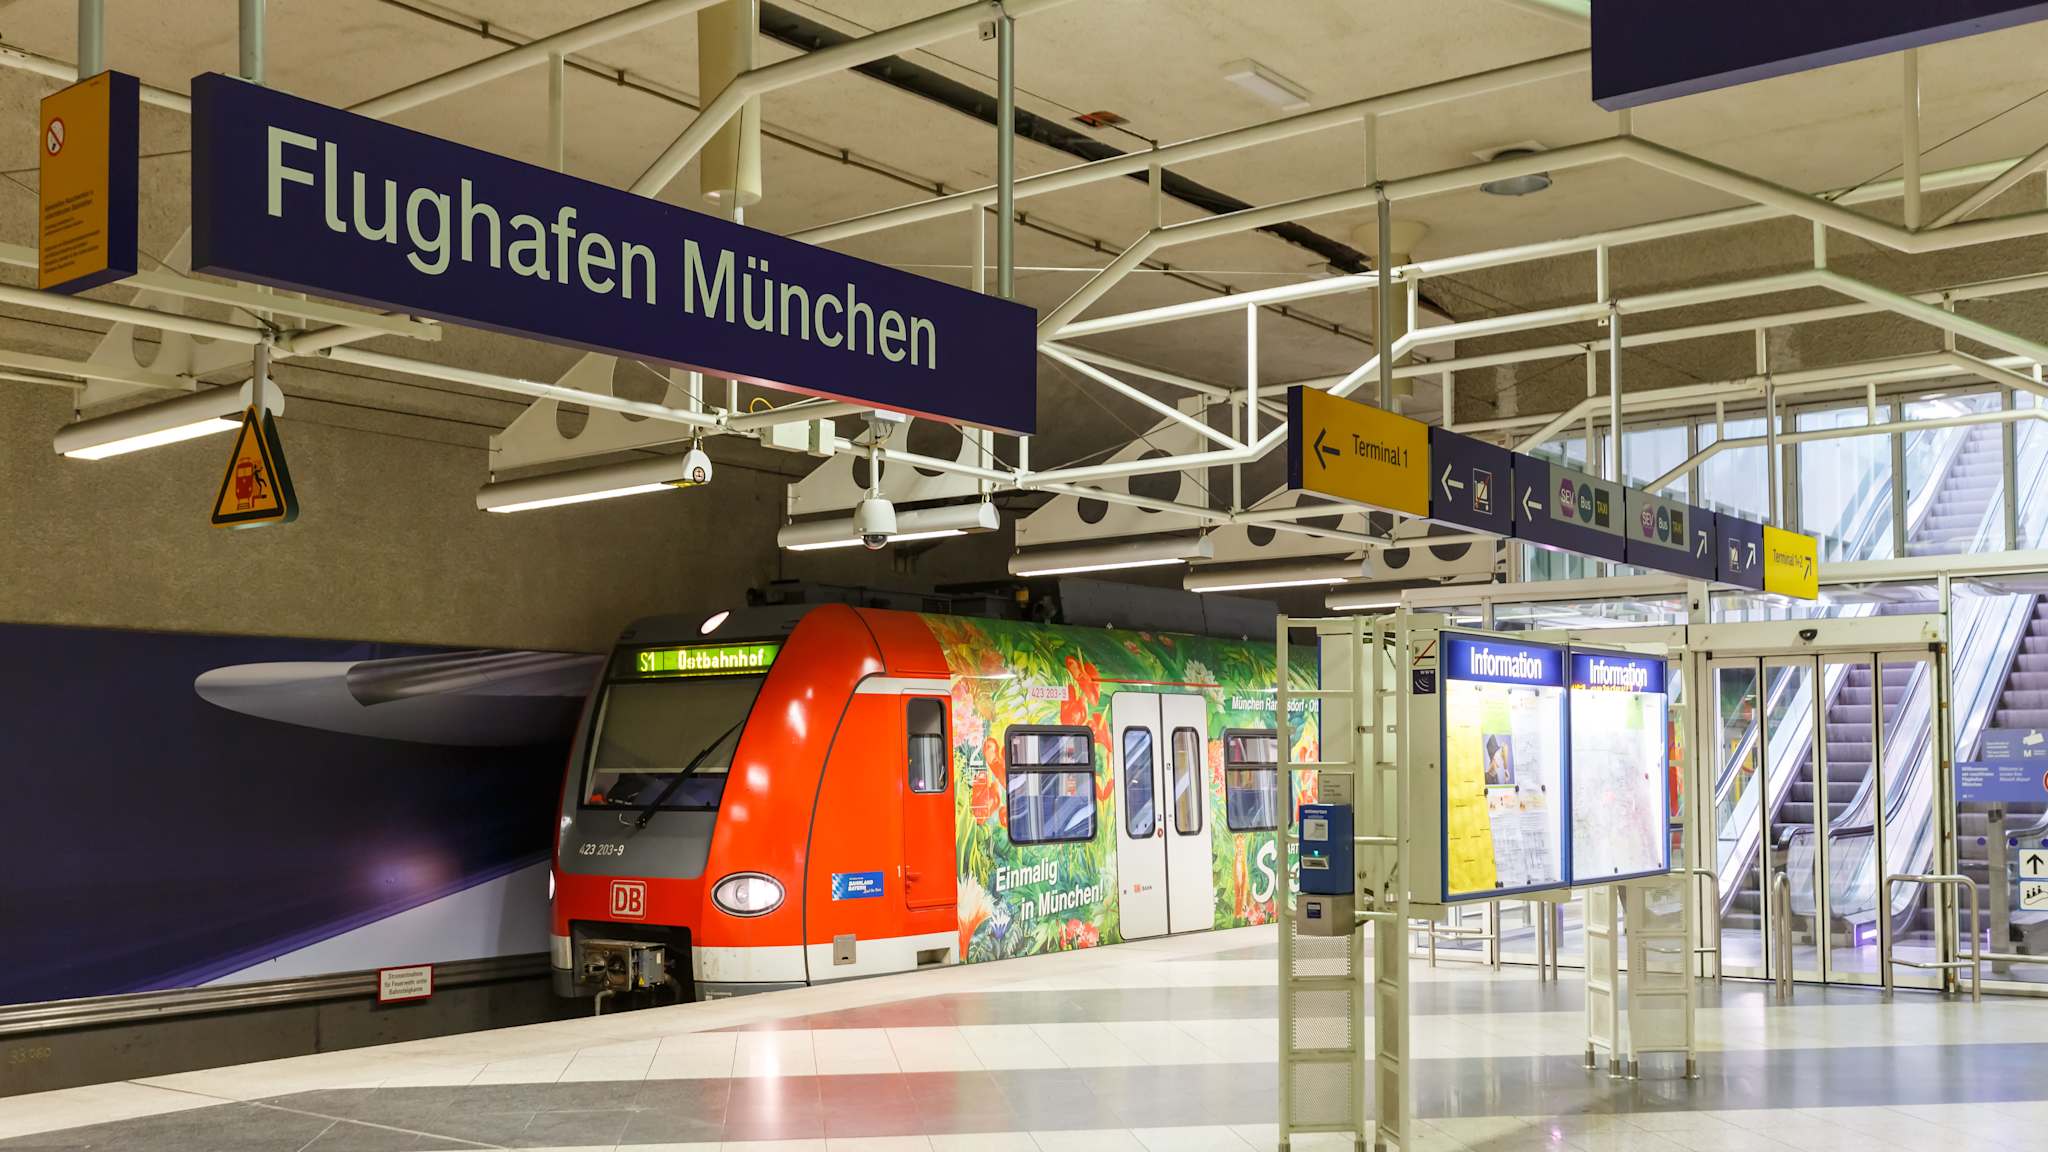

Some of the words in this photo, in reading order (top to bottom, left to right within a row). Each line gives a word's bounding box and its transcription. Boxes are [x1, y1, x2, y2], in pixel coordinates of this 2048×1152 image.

[268, 125, 657, 305] Flughafen
[684, 238, 936, 370] München
[1352, 433, 1400, 466] Terminal
[1403, 449, 1408, 469] 1
[1560, 488, 1575, 505] SEV
[1580, 496, 1591, 510] Bus
[1597, 500, 1608, 515] TAXI
[1642, 511, 1654, 526] SEV
[1658, 517, 1668, 530] Bus
[640, 651, 655, 672] S1
[678, 648, 765, 670] Ostbahnhof
[1470, 646, 1543, 679] Information
[1589, 658, 1648, 688] Information
[1231, 696, 1265, 711] München
[580, 844, 596, 856] 423
[996, 857, 1059, 892] Einmalig
[615, 887, 641, 912] DB
[1021, 897, 1035, 921] in
[1038, 878, 1105, 918] München!
